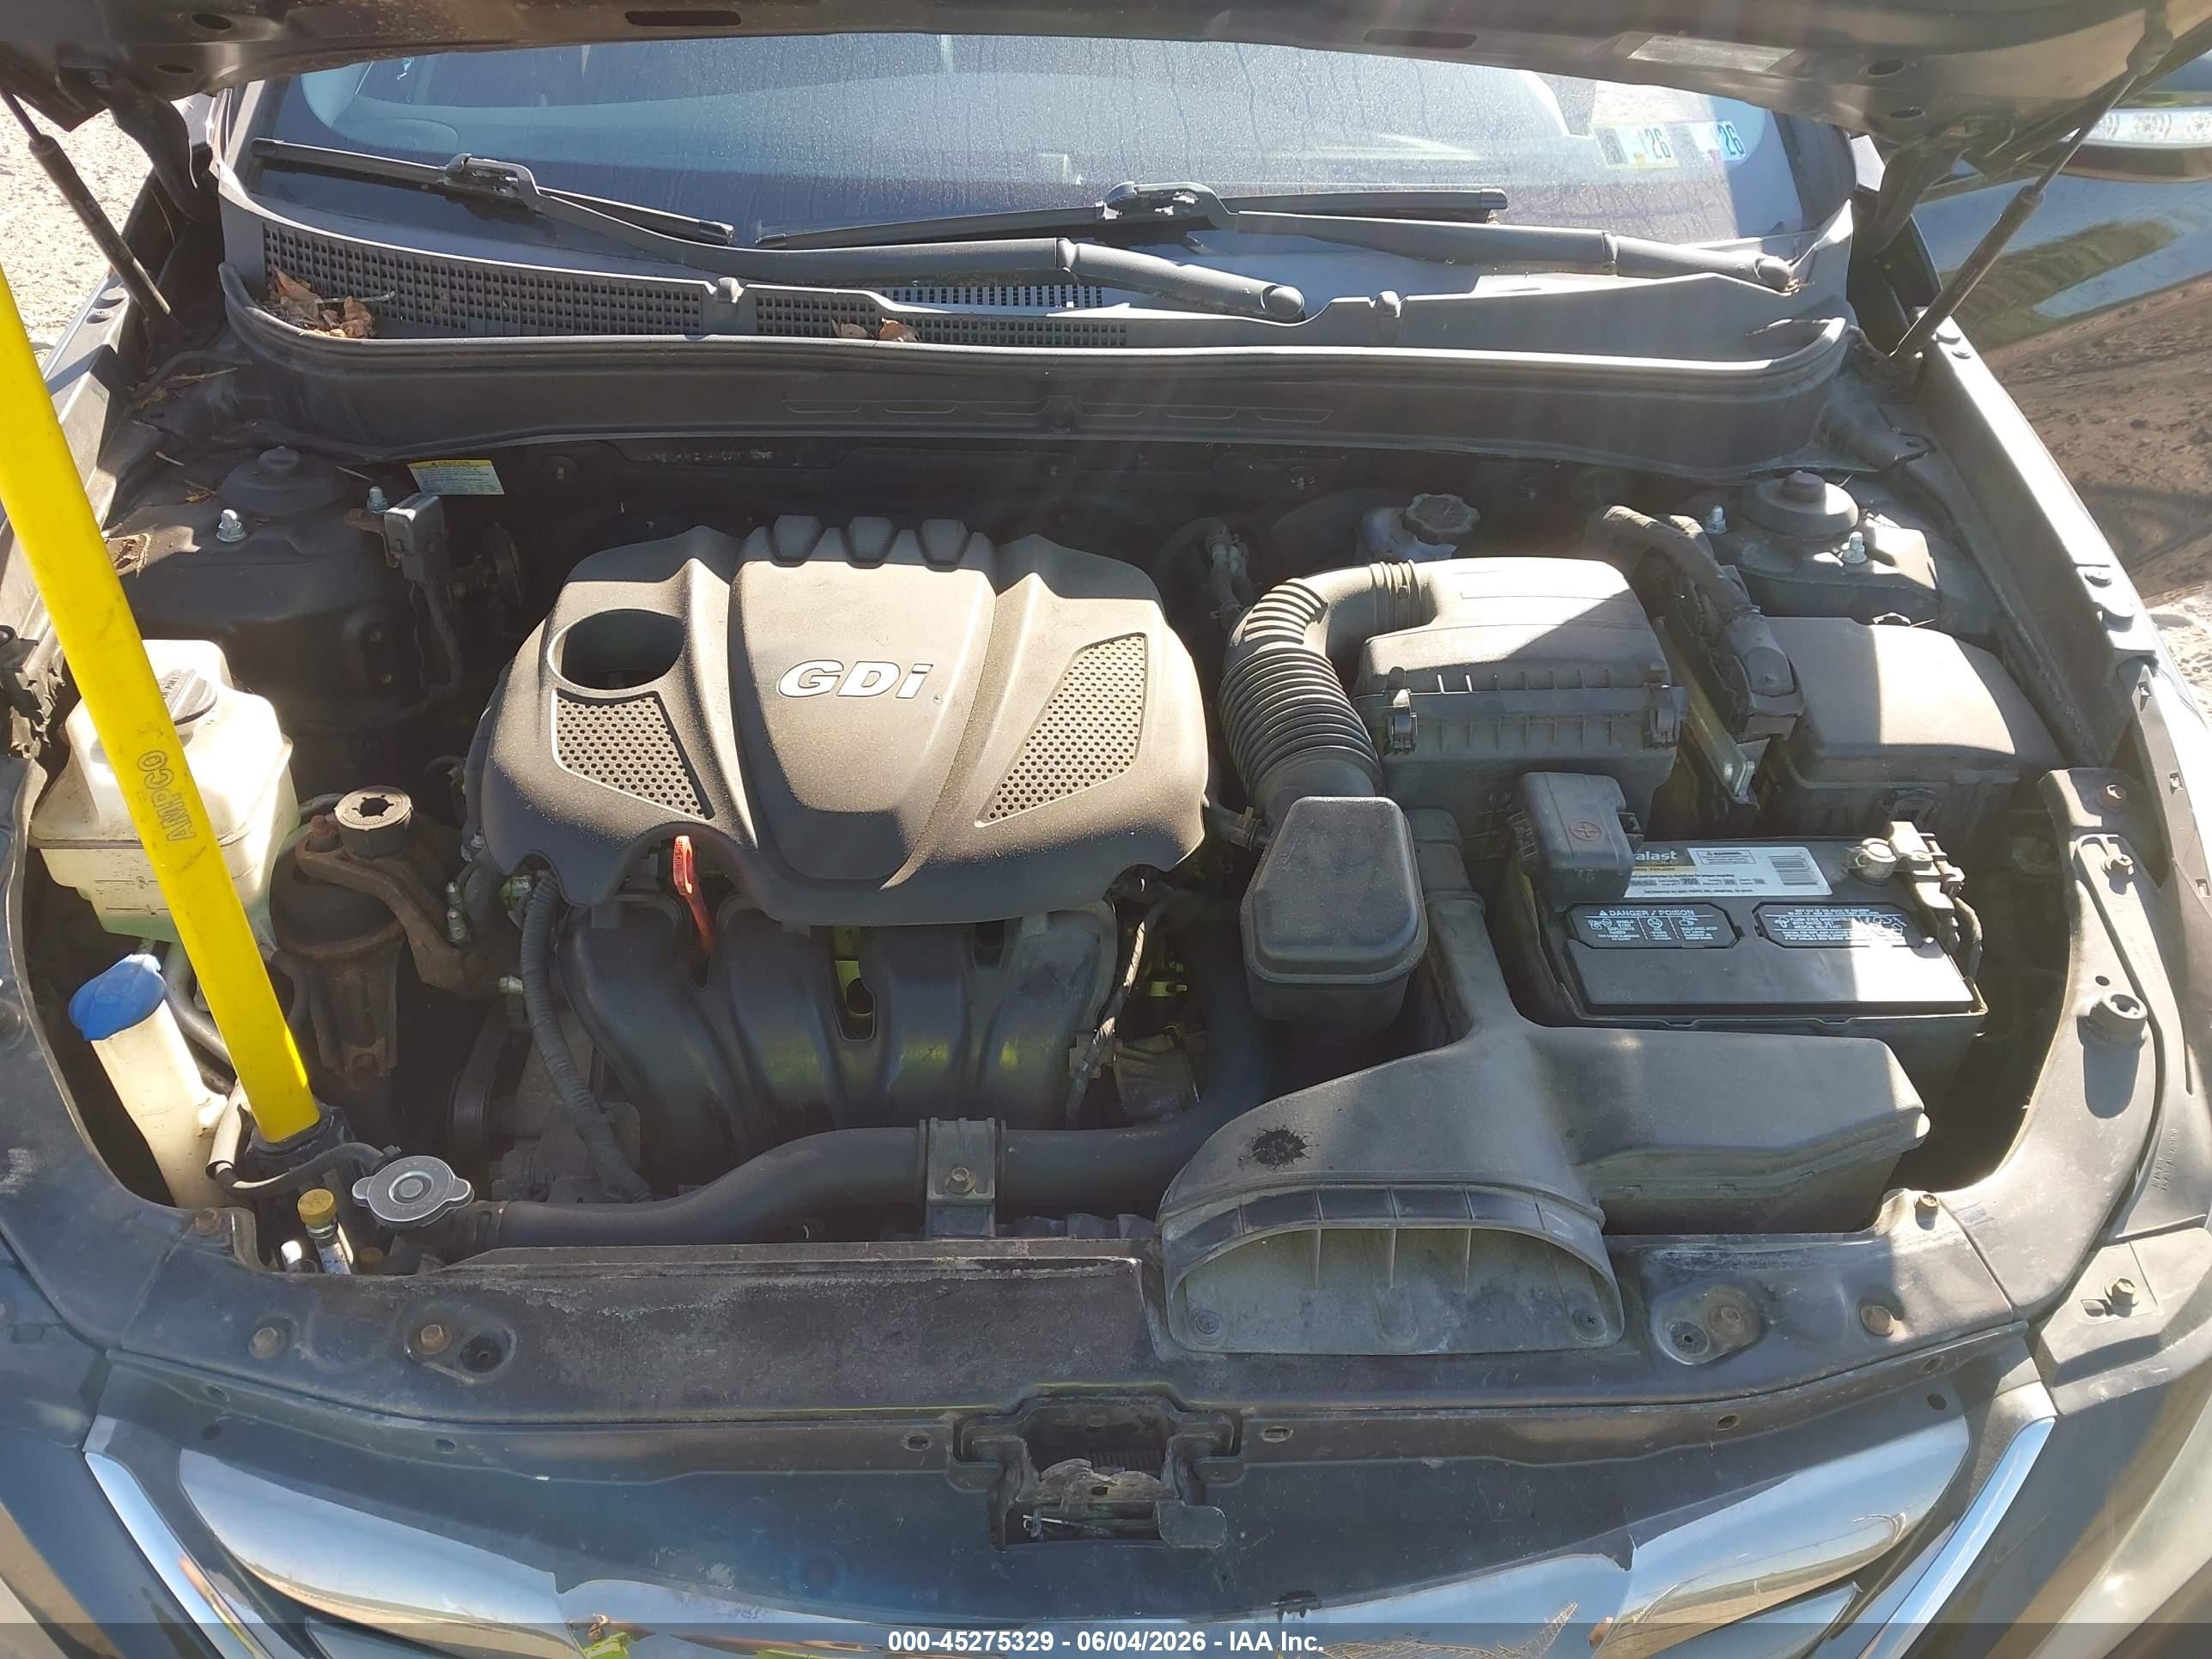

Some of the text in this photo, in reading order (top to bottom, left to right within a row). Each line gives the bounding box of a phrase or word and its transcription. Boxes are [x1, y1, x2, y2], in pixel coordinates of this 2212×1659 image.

[1717, 124, 1746, 158] 26
[778, 659, 934, 699] GDi
[137, 750, 197, 842] AMPCO
[1633, 851, 1678, 860] alast
